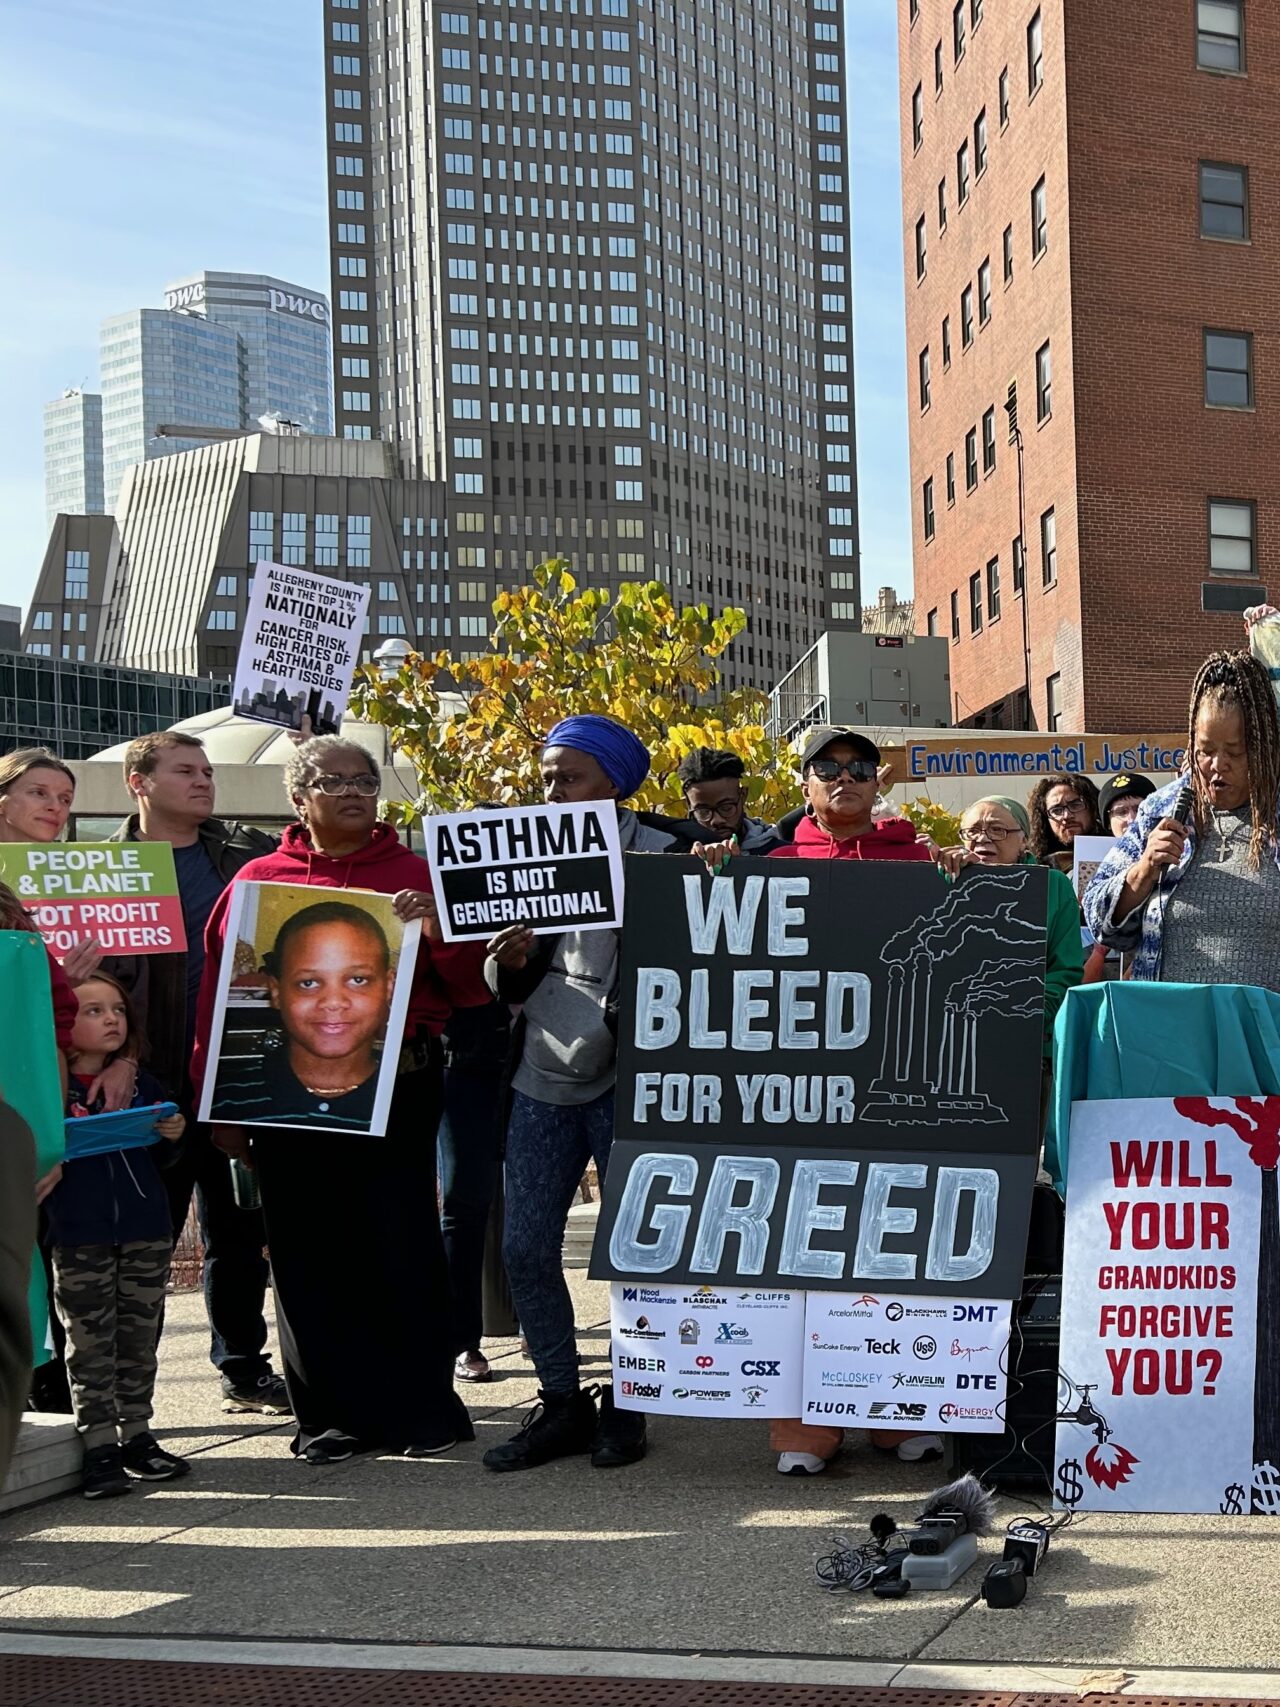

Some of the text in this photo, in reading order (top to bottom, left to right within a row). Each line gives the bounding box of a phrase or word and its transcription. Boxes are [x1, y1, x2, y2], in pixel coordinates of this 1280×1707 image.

[269, 289, 325, 320] pwc
[267, 570, 364, 602] ALLEGHENY COUNTY
[270, 582, 356, 613] IS IN THE TOP 1%
[265, 593, 357, 630] NATIONALY
[260, 620, 313, 643] CANCER
[300, 618, 319, 631] FOR
[255, 633, 351, 666] HIGH RATES OF
[266, 650, 334, 675] ASTHMA &
[252, 659, 344, 691] HEART ISSUES
[911, 742, 1185, 776] Environmental Justice
[437, 811, 608, 867] ASTHMA
[27, 850, 140, 871] PEOPLE
[18, 873, 154, 895] & PLANET
[486, 867, 557, 895] IS NOT
[80, 902, 160, 924] PROFIT
[452, 891, 608, 926] GENERATIONAL
[683, 875, 810, 957] WE
[634, 967, 872, 1051] BLEED
[633, 1072, 856, 1123] FOR YOUR
[1110, 1139, 1232, 1188] WILL
[609, 1153, 1000, 1282] GREED
[1103, 1201, 1230, 1251] YOUR
[1098, 1265, 1236, 1291] GRANDKIDS
[640, 1288, 660, 1296] Wood
[640, 1296, 677, 1304] Mackenzie
[828, 1309, 873, 1318] ArcelorMittal
[953, 1305, 998, 1322] DMT
[1099, 1305, 1234, 1339] FORGIVE
[840, 1344, 861, 1352] Energy
[865, 1339, 900, 1354] Teck
[619, 1356, 666, 1372] EMBER
[741, 1360, 781, 1376] CSX
[1105, 1348, 1222, 1396] YOU?
[821, 1371, 882, 1383] McCLOSKEY
[906, 1376, 945, 1385] JAVELIN
[956, 1374, 997, 1390] DTE
[632, 1382, 662, 1398] Fosbel
[690, 1390, 731, 1398] POWERS
[807, 1401, 856, 1415] FLUOR
[959, 1408, 994, 1416] ENERGY
